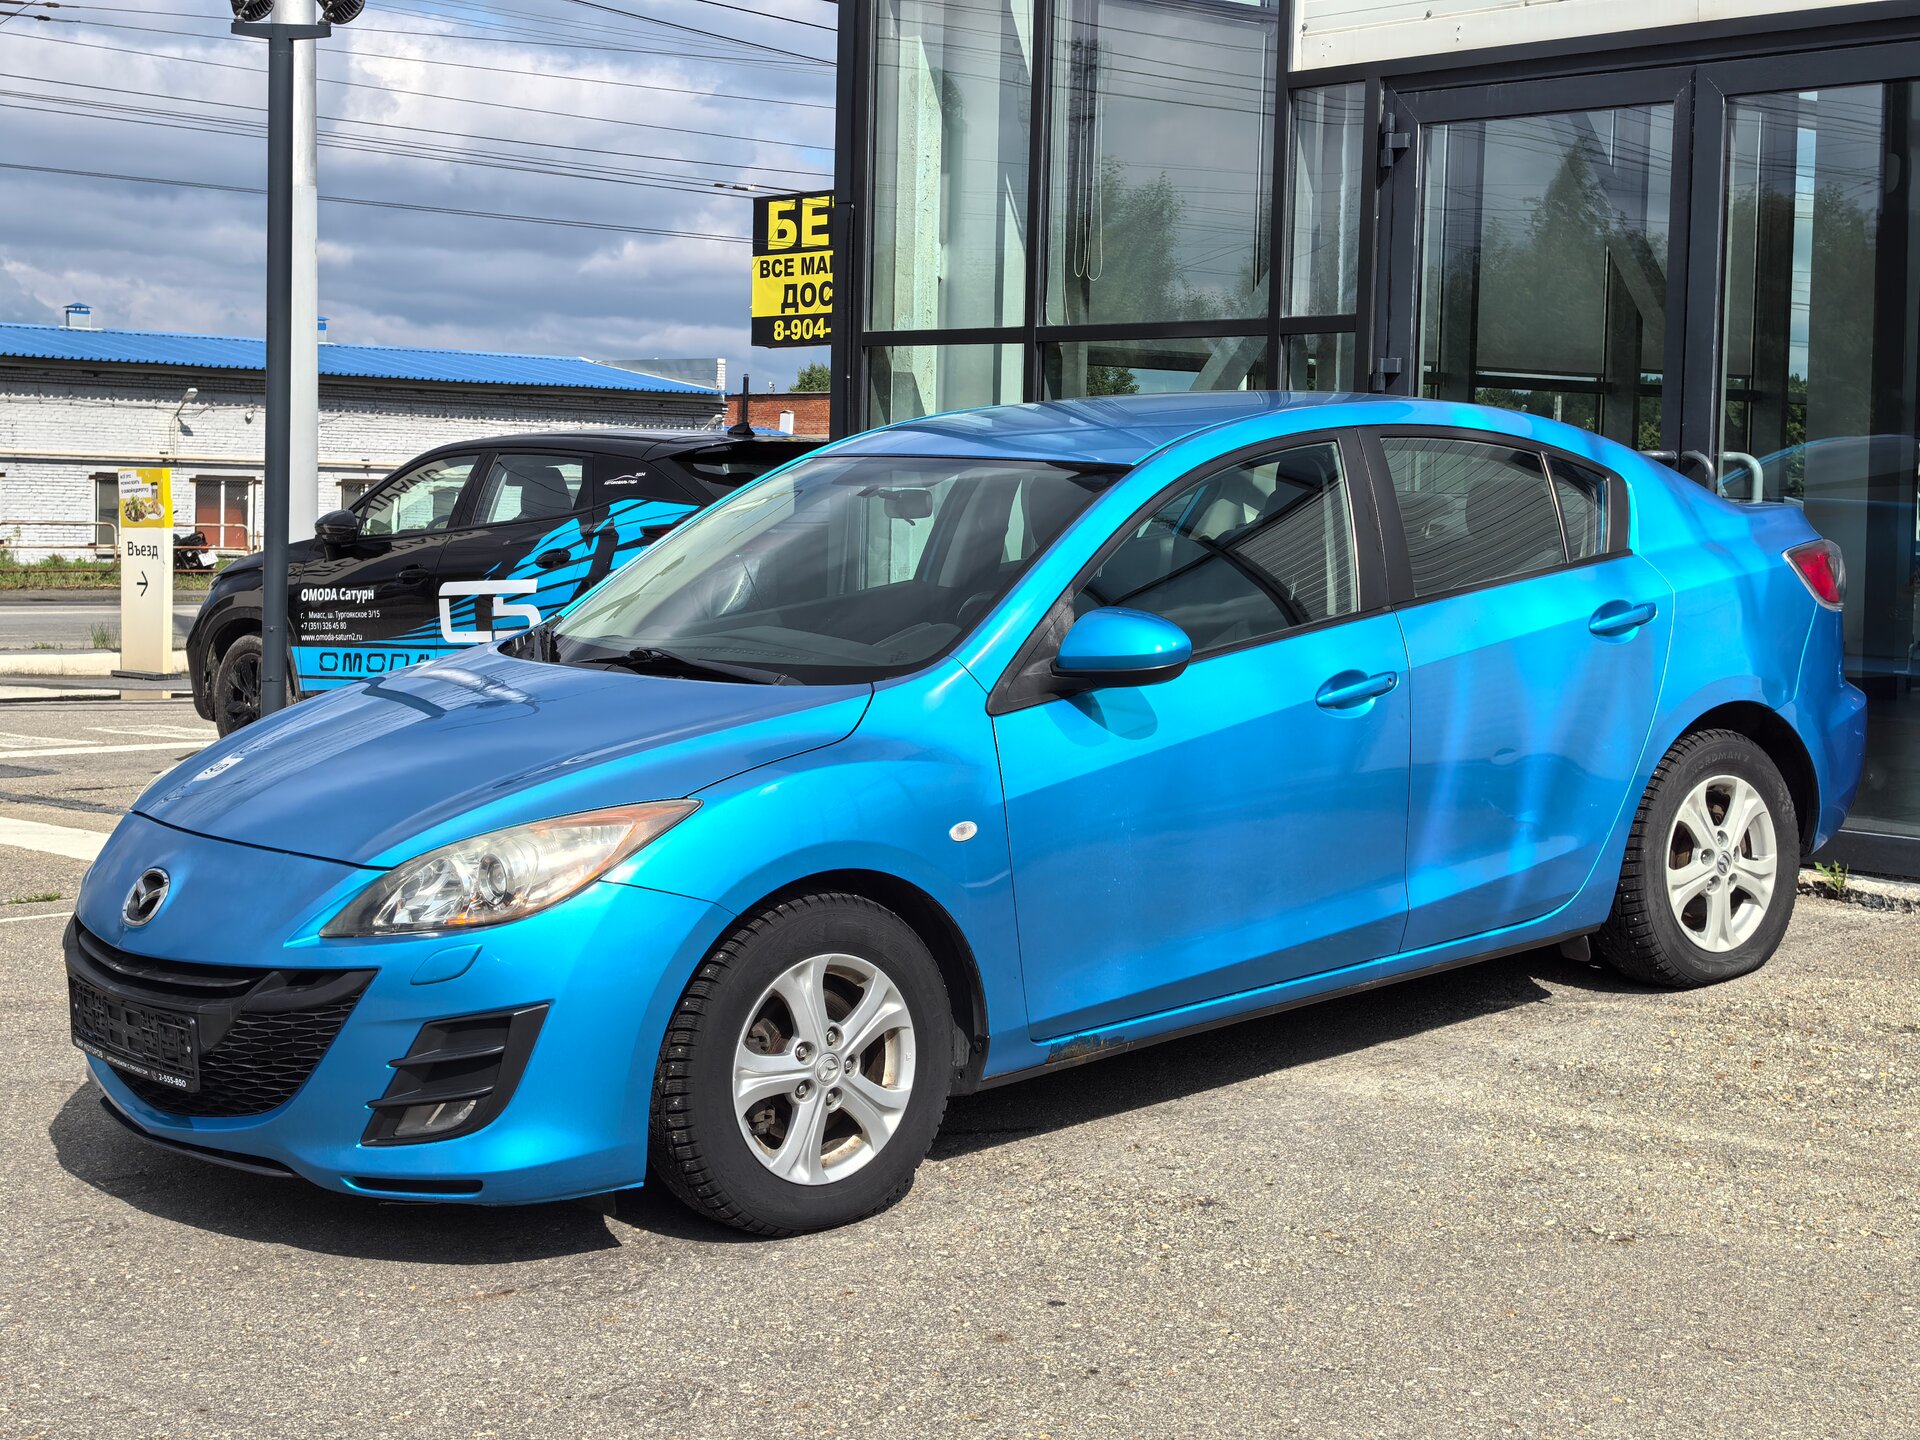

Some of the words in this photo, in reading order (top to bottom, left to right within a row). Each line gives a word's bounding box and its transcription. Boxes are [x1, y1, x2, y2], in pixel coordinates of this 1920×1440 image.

[767, 195, 834, 251] БЕ
[759, 257, 795, 278] ВСЕ
[780, 281, 833, 314] ДОС
[773, 317, 831, 341] 8-904-
[127, 541, 159, 559] Въезд
[301, 588, 337, 601] OMODA
[340, 588, 374, 603] Сатурн
[308, 611, 327, 619] Миасс,
[368, 610, 380, 618] 3/15
[300, 622, 307, 630] +7
[308, 621, 322, 631] (351)
[322, 621, 332, 630] 326
[340, 621, 347, 630] 80
[301, 632, 363, 641] www.omoda-saturn2.ru
[158, 1073, 187, 1088] 2-555-850
